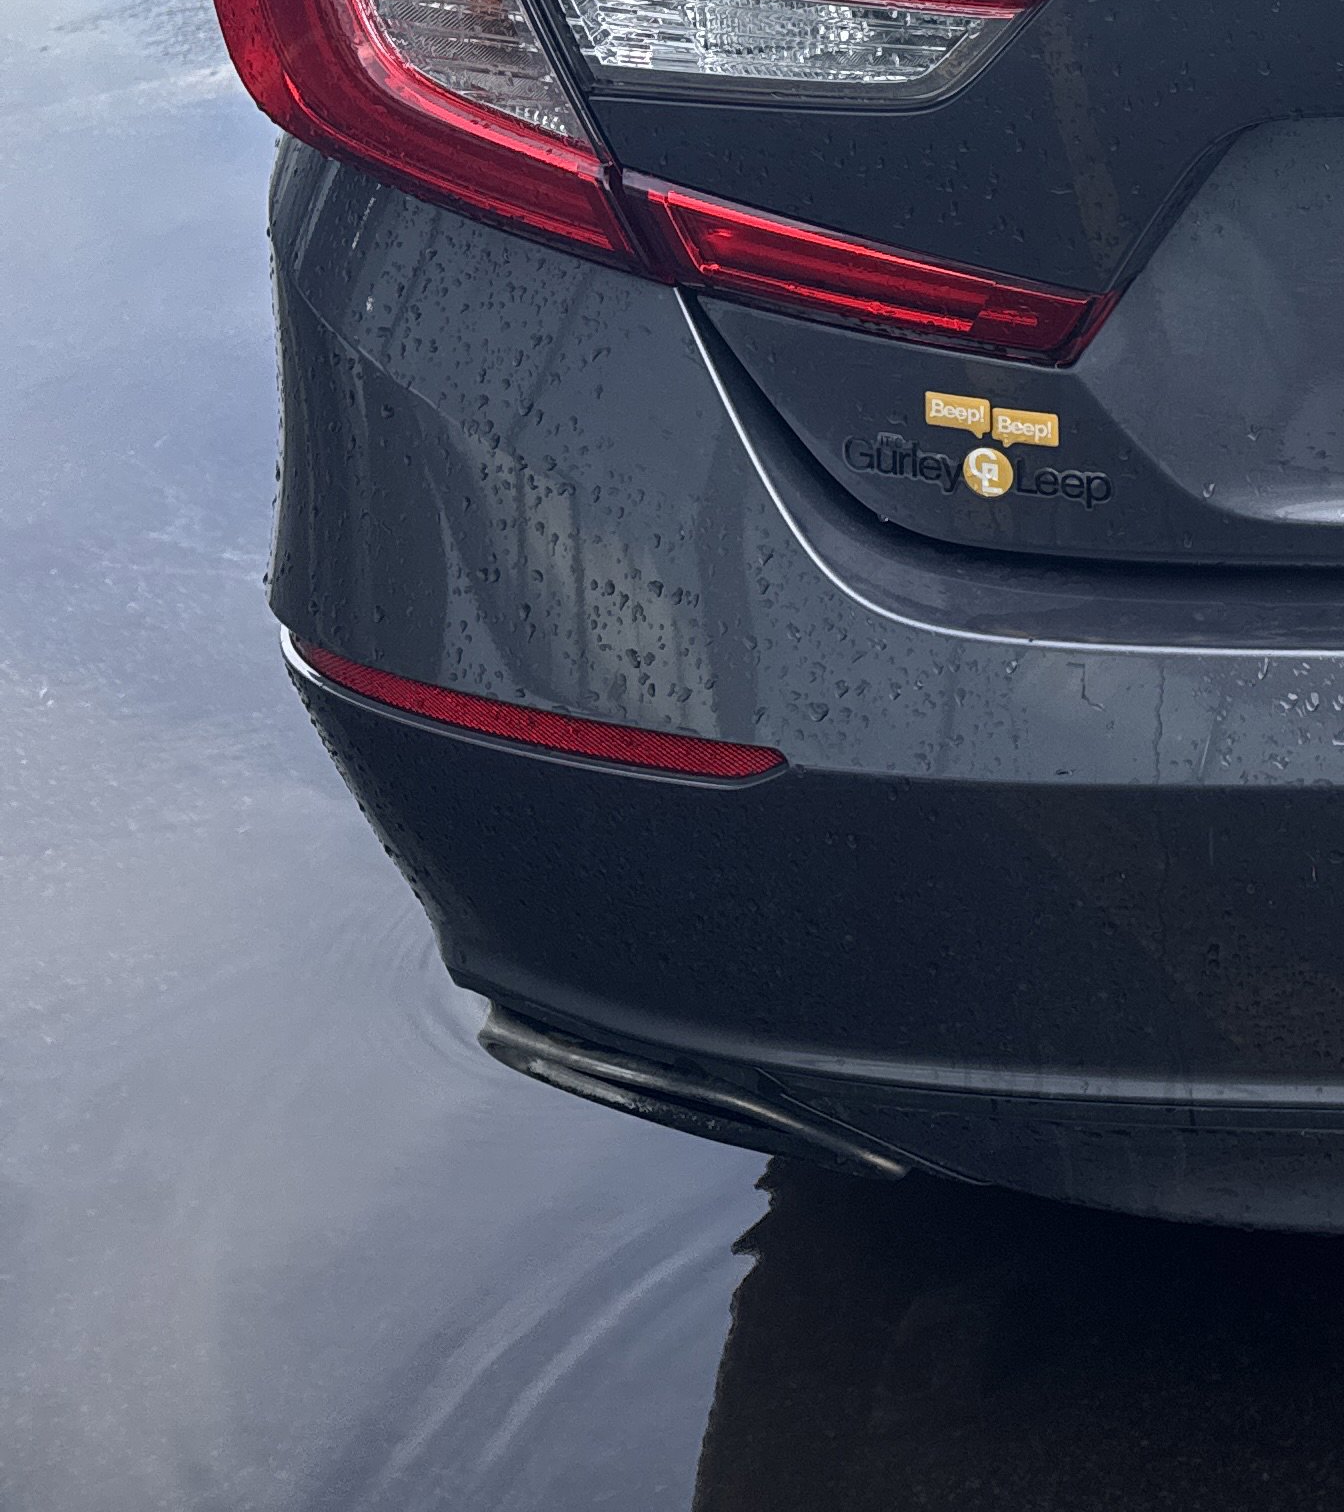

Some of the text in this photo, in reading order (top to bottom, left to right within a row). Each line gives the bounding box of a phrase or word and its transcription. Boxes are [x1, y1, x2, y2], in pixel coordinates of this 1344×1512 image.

[930, 399, 1052, 443] Beep! Beep!
[844, 438, 962, 493] Gurley
[1015, 457, 1112, 509] Leep
